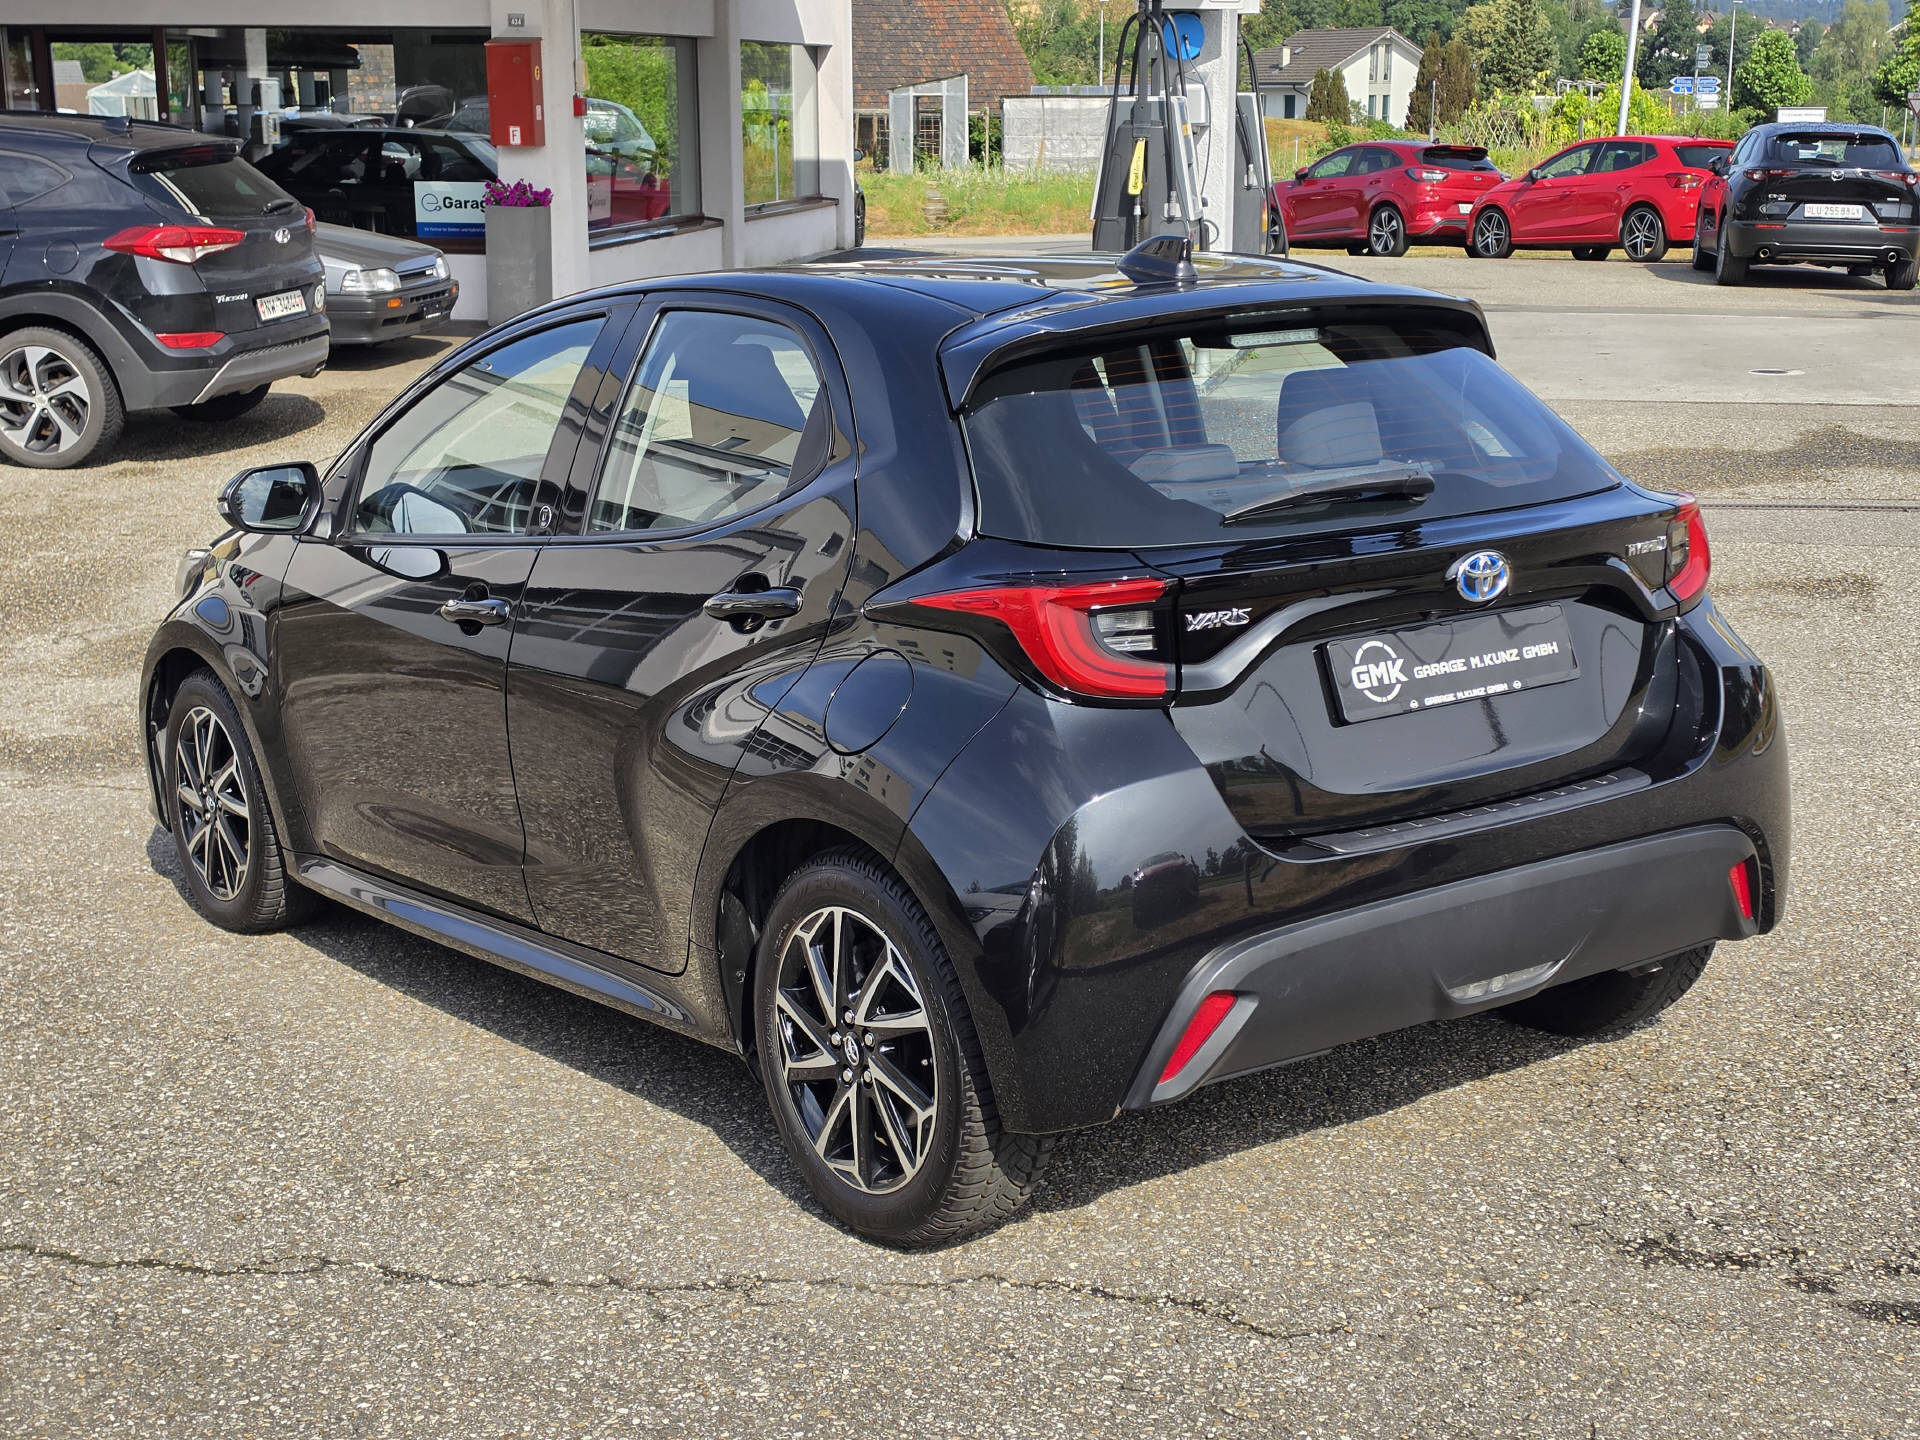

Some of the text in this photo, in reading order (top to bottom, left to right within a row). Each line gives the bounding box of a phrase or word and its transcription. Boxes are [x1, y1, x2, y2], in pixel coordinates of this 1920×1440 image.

[511, 129, 519, 142] F
[1811, 206, 1822, 215] LU
[1185, 607, 1253, 632] YARIS
[1413, 641, 1559, 679] GARAGE M.KUNZ GMBH
[1351, 658, 1409, 690] GMK
[1424, 692, 1456, 706] GARAGE
